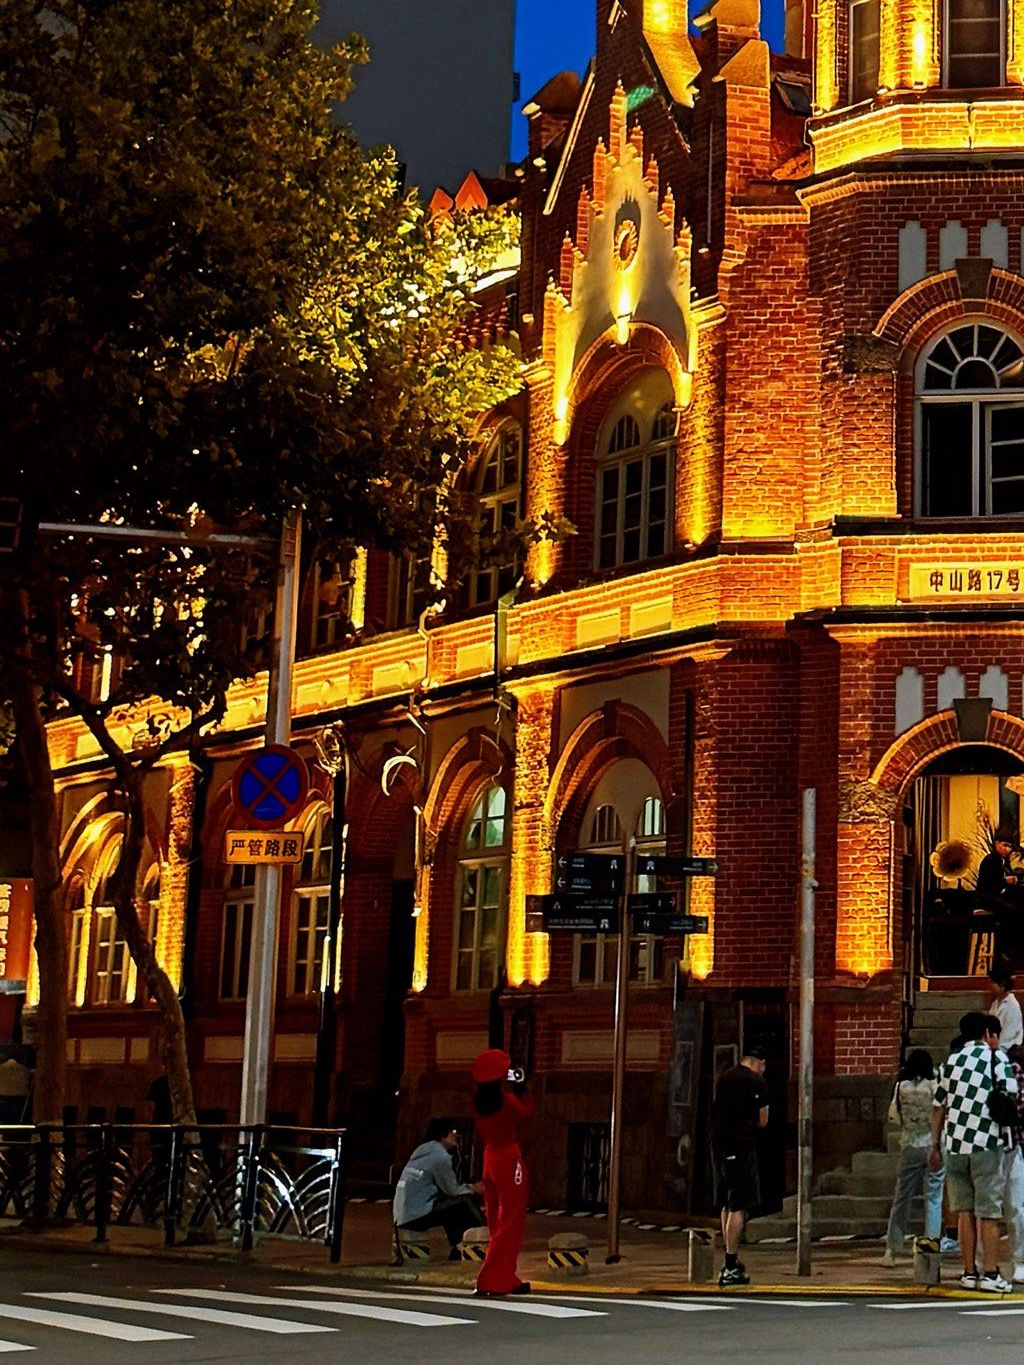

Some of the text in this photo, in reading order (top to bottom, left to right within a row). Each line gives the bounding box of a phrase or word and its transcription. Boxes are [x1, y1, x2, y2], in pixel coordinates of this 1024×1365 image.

[929, 569, 1020, 592] 中山路17号
[229, 839, 298, 857] 严管路段
